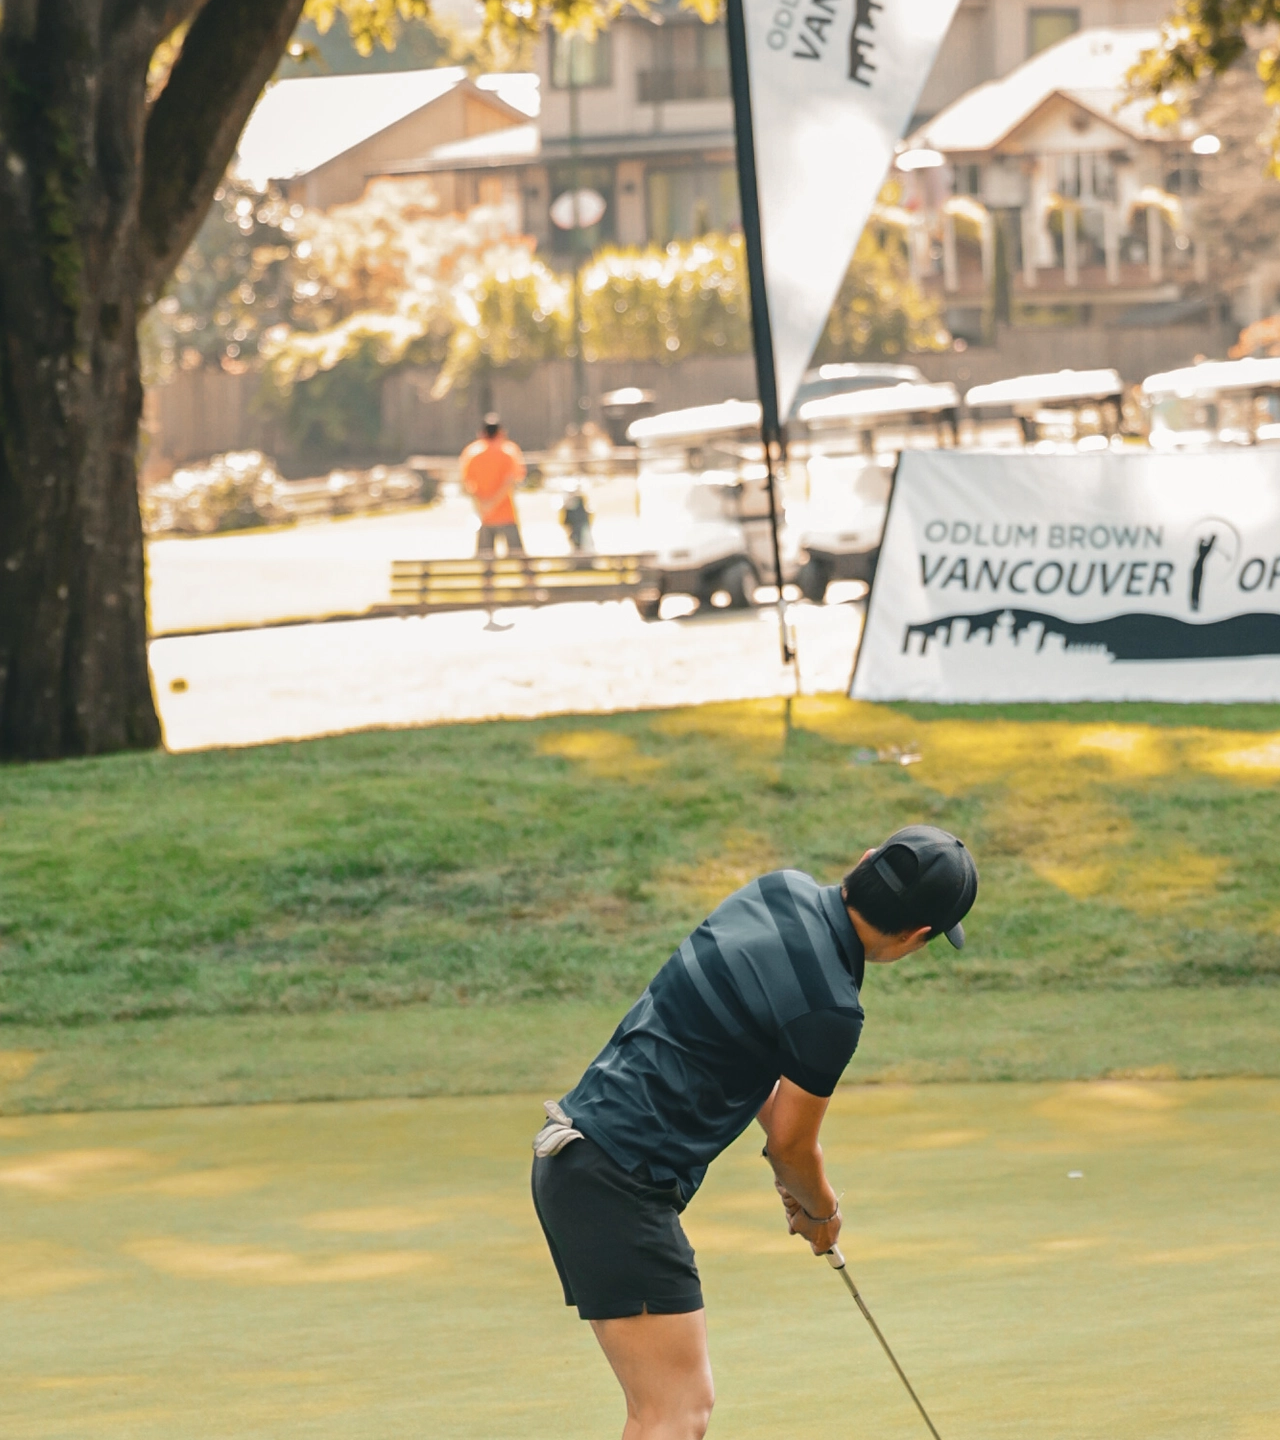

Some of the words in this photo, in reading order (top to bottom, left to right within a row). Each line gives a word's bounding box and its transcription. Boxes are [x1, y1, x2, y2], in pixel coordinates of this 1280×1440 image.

[924, 519, 1038, 549] ODLUM
[1048, 524, 1163, 550] BROWN
[919, 554, 1174, 596] VANCOUVER
